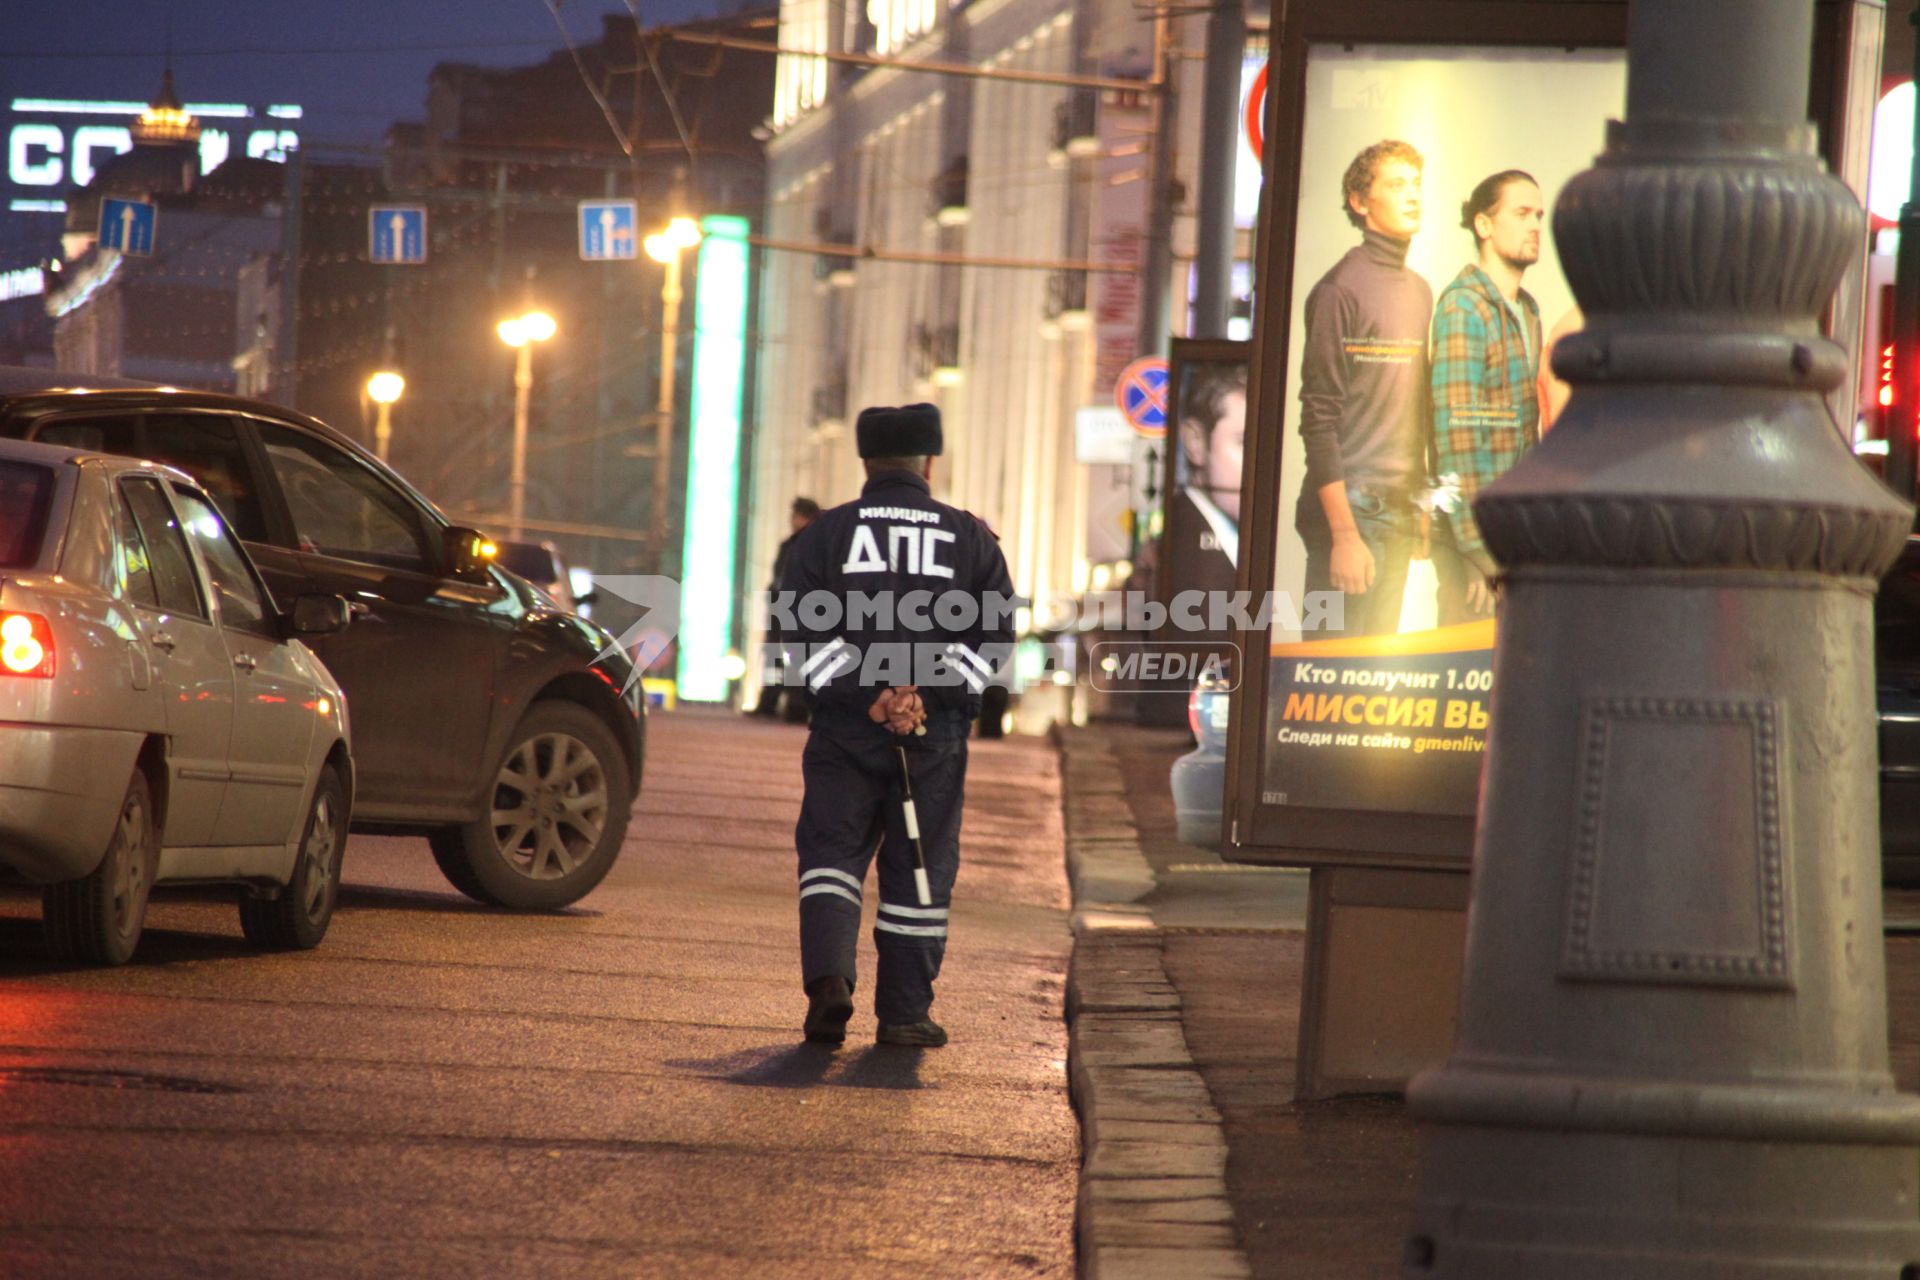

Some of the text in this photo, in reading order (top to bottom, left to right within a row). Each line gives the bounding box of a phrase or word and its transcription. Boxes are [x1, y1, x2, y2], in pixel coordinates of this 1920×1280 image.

[859, 506, 940, 524] МИЛИЦИЯ
[842, 524, 956, 579] ДПС
[1294, 663, 1337, 684] Кто
[1341, 669, 1439, 692] получит
[1282, 693, 1437, 728] МИССИЯ
[1277, 728, 1332, 746] Следи
[1335, 734, 1358, 746] на
[1361, 732, 1411, 749] сайте
